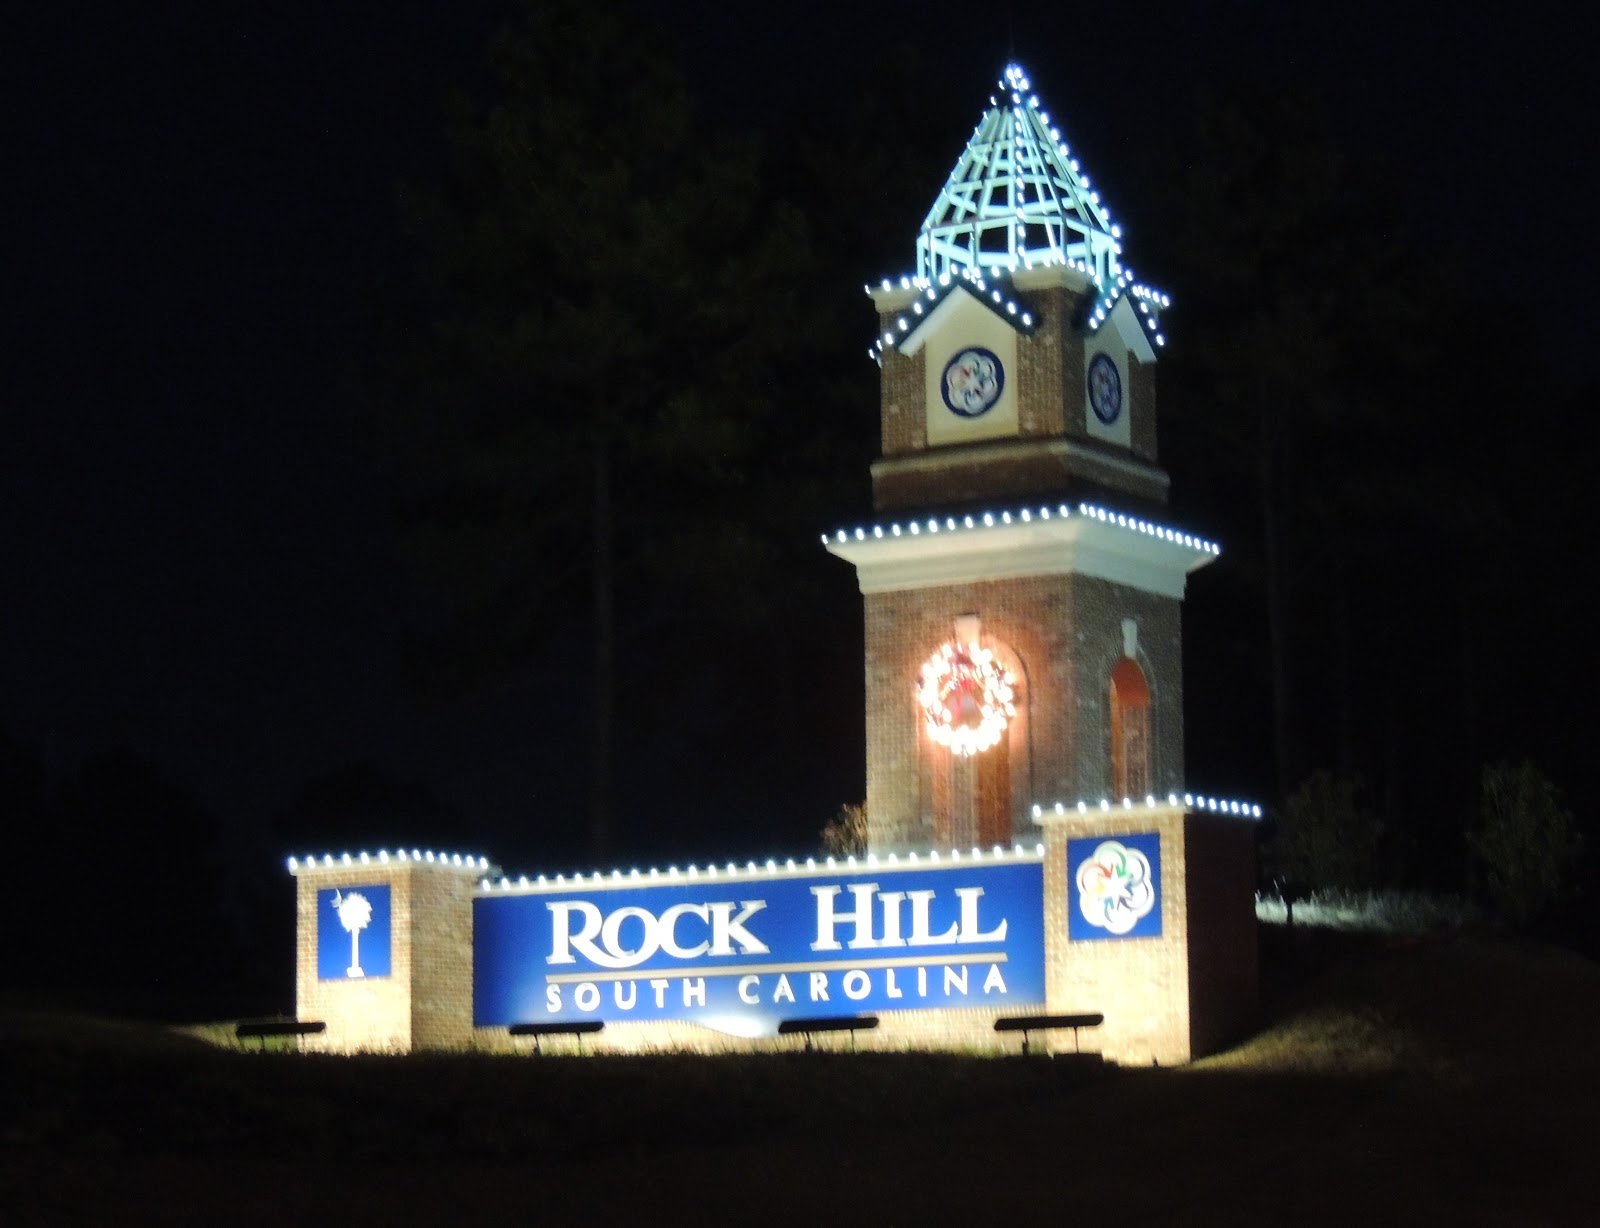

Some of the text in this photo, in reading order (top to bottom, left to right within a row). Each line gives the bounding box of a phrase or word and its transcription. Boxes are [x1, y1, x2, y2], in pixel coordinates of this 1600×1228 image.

[546, 882, 1008, 968] ROCK HILL
[546, 963, 1008, 1013] SOUTH CAROLINA
